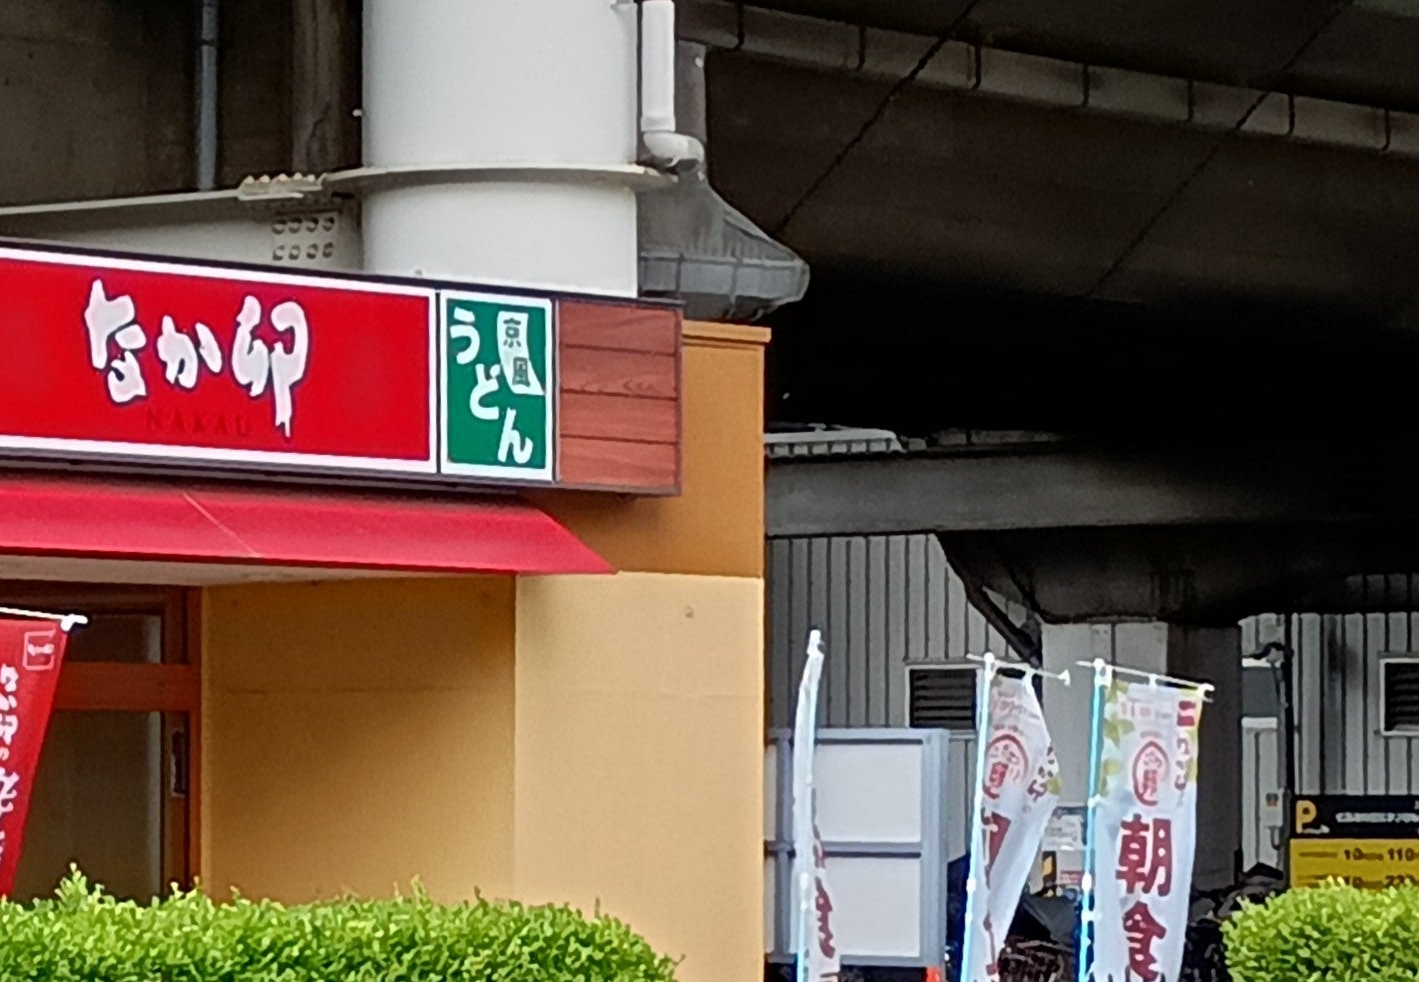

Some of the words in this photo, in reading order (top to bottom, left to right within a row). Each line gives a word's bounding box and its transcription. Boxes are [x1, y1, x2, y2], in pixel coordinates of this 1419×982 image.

[84, 278, 309, 438] なか卯
[145, 408, 251, 437] NAKAU
[449, 306, 535, 465] うどん
[1295, 799, 1318, 834] P
[1114, 813, 1172, 982] 朝食
